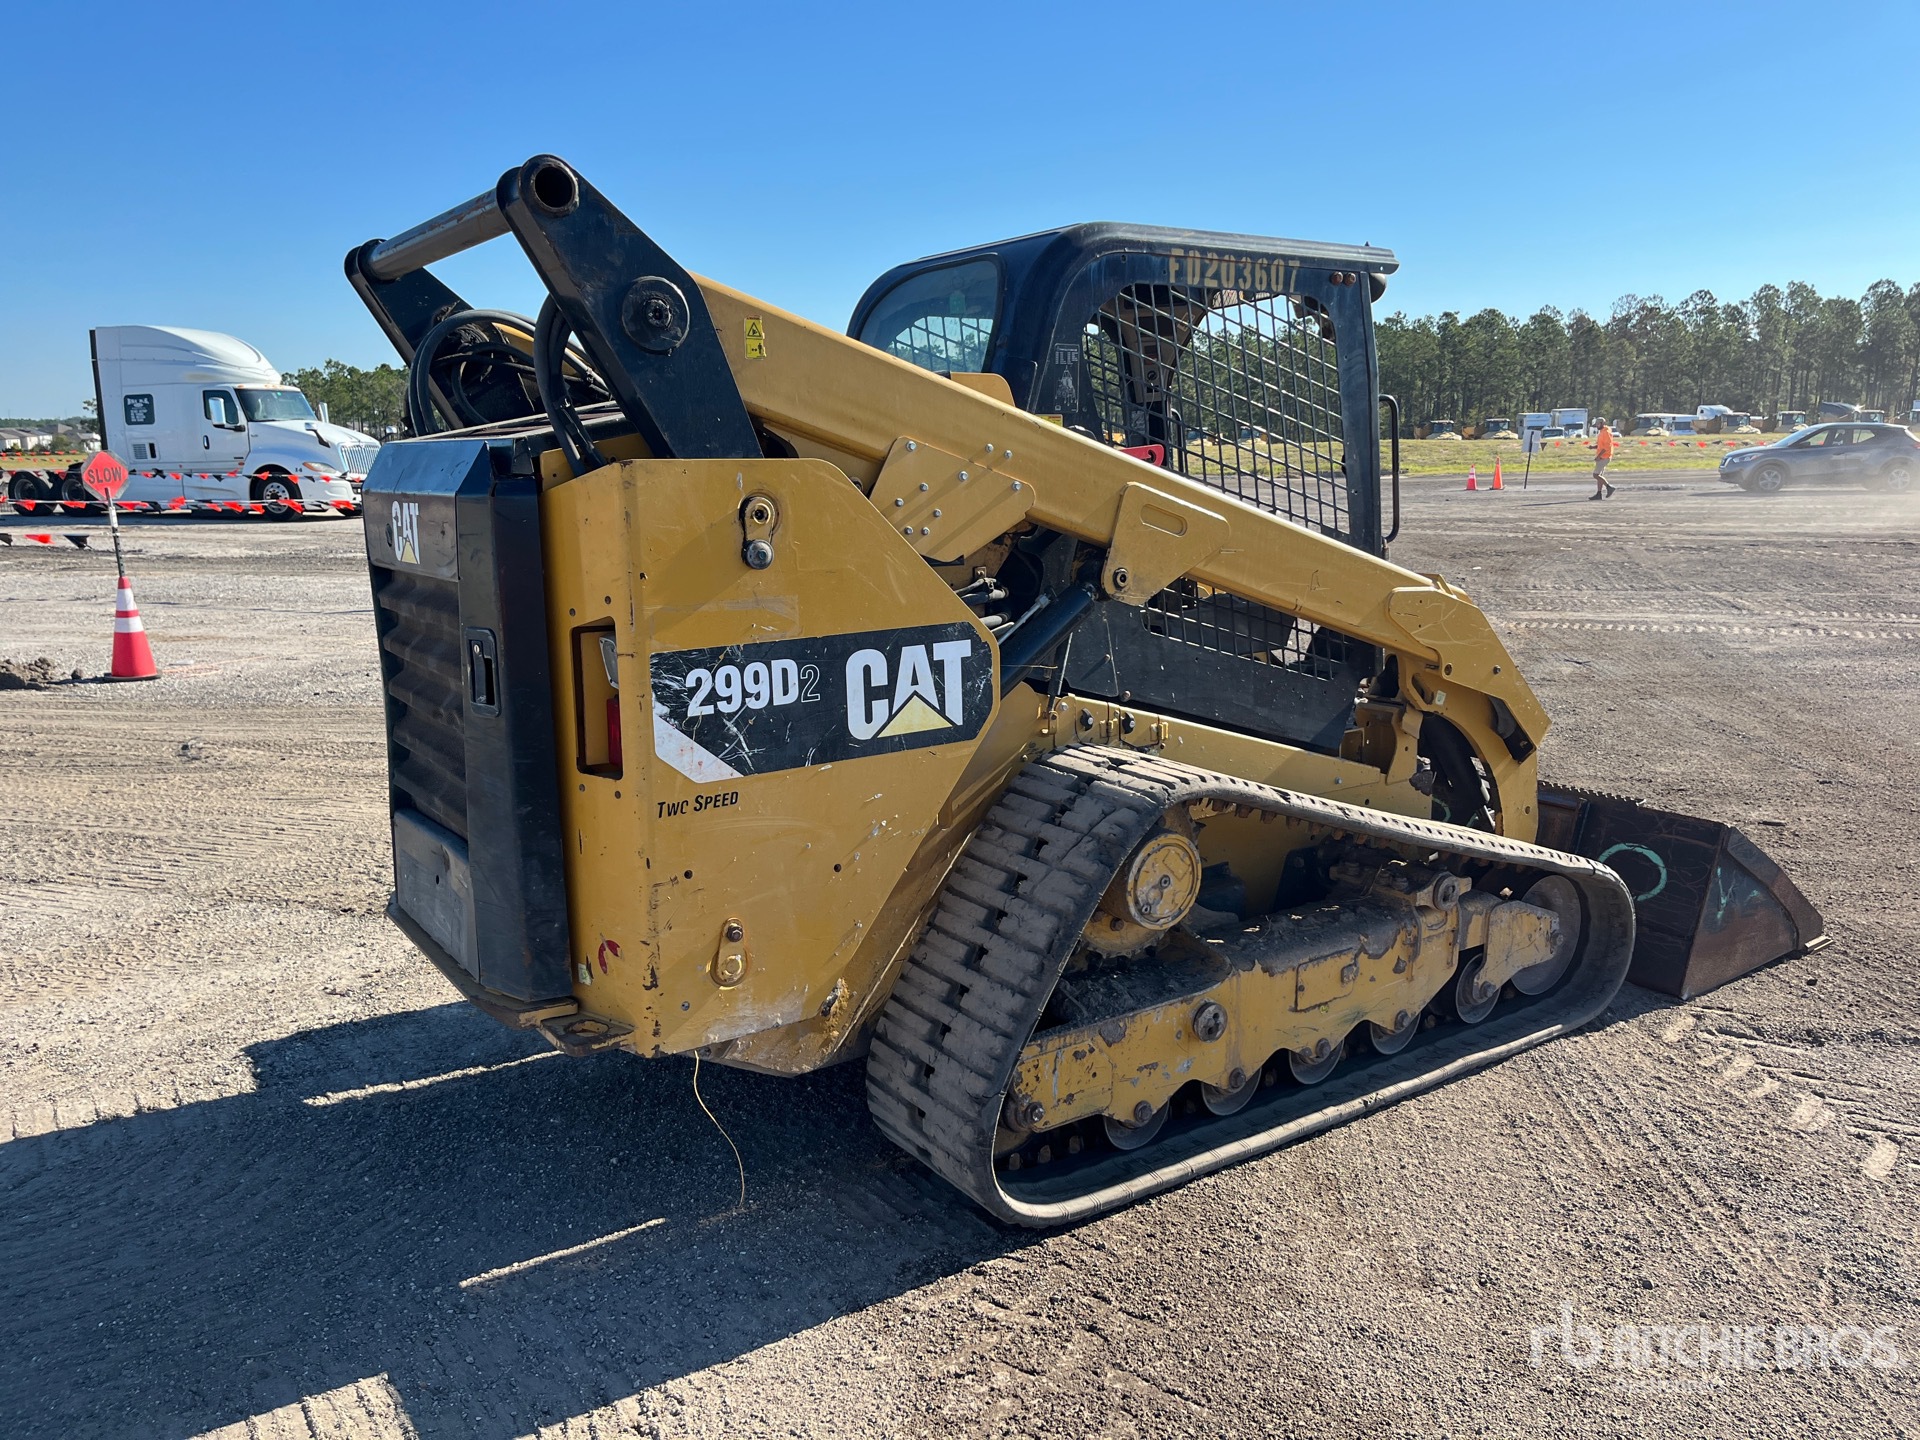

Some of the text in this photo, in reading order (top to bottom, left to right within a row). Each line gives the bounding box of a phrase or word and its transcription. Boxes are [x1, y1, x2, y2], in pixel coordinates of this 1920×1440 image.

[1169, 248, 1300, 293] FD203607
[87, 466, 122, 484] SLOW
[391, 500, 420, 565] CAT
[685, 657, 821, 717] 299D2
[845, 639, 972, 740] CAT
